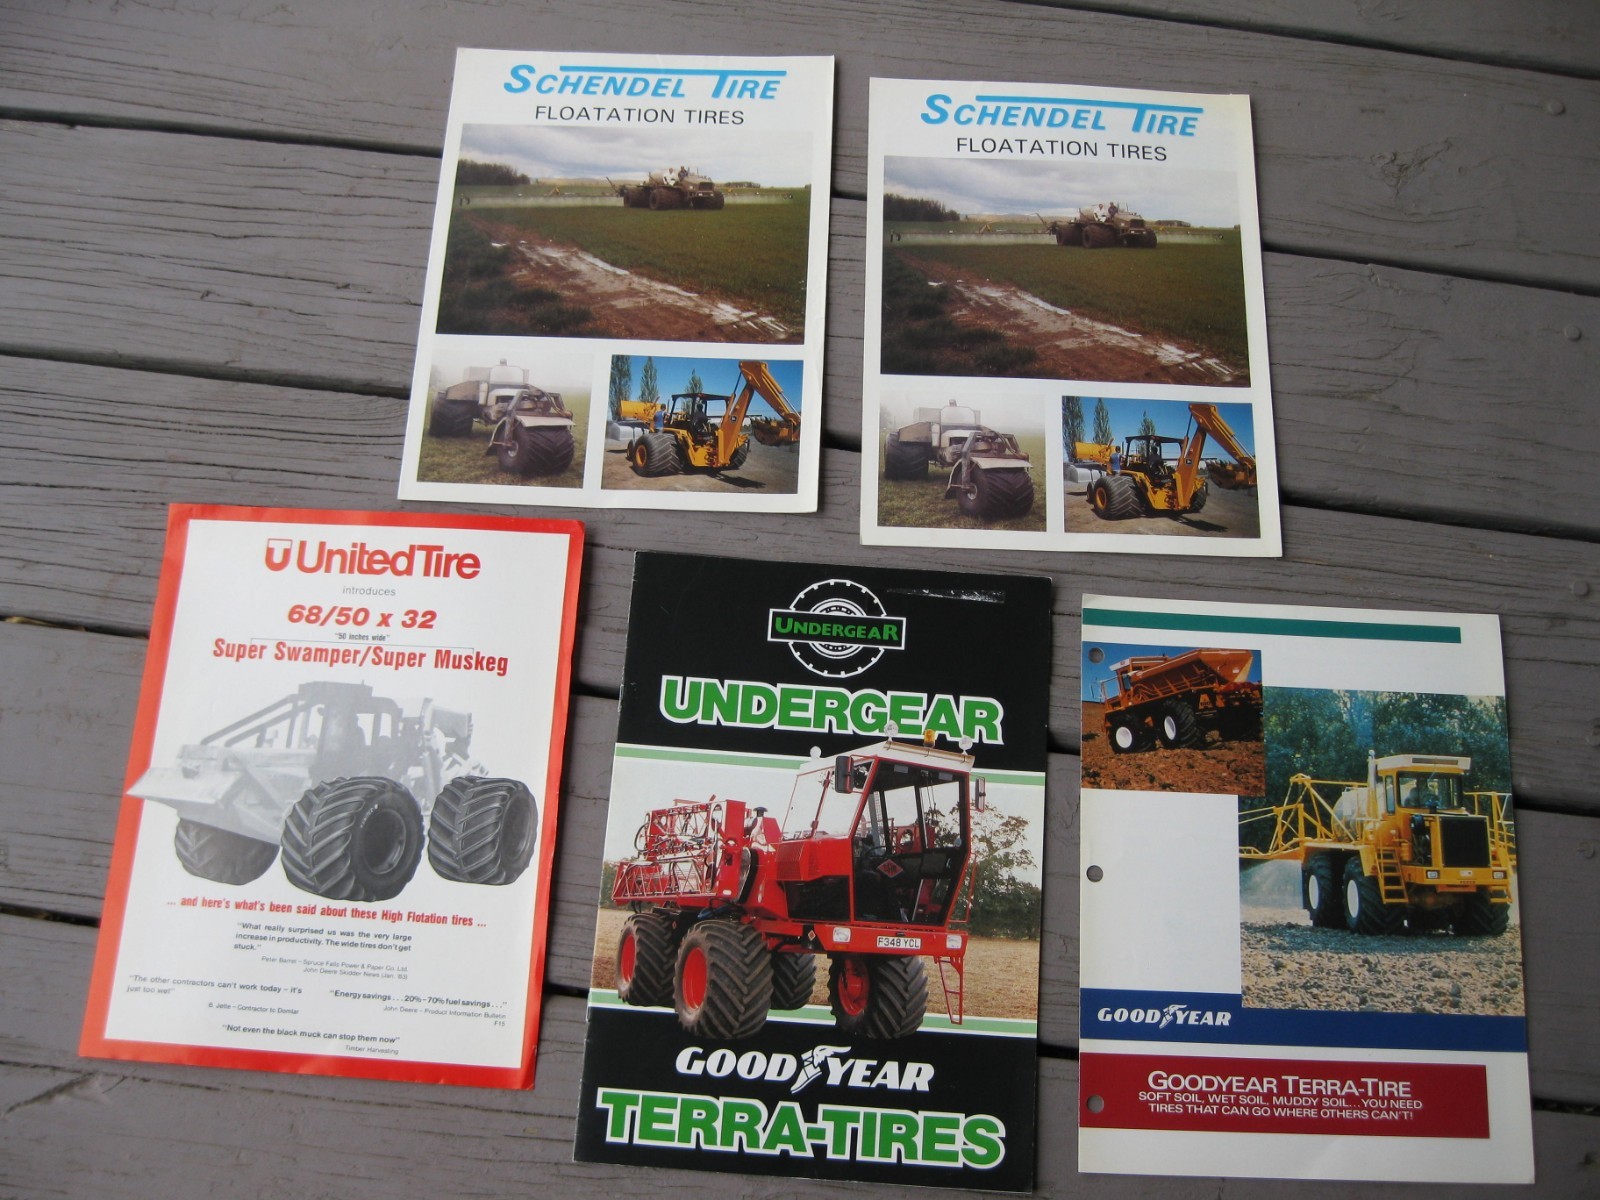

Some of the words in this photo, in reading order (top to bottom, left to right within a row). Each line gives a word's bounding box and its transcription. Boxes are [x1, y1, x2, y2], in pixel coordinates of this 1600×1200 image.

[503, 64, 686, 98] SCHENDEL
[710, 71, 787, 100] TIRE
[536, 105, 675, 123] FLOATATION
[684, 109, 744, 125] TIRES
[920, 94, 1106, 131] SCHENDEL
[1131, 106, 1203, 136] TIRE
[957, 138, 1098, 156] FLOATATION
[1107, 143, 1167, 161] TIRES
[343, 586, 396, 596] introduces
[288, 604, 370, 626] 68/50
[377, 612, 394, 628] x
[401, 610, 437, 629] 32
[349, 633, 369, 641] inches
[775, 617, 899, 642] UNDERGEAR
[213, 638, 267, 662] Super
[434, 649, 508, 676] Muskeg
[660, 674, 1004, 745] UNDERGEAR
[181, 897, 198, 906] and
[202, 897, 230, 908] here's
[235, 900, 265, 911] what's
[270, 901, 292, 913] been
[297, 904, 316, 915] said
[321, 906, 347, 917] about
[351, 908, 377, 919] these
[382, 910, 402, 923] High
[407, 912, 447, 924] Flotation
[452, 915, 473, 926] tires
[265, 925, 285, 933] really
[288, 926, 323, 935] surprised
[236, 933, 267, 941] increase
[278, 936, 323, 946] productivity.
[341, 940, 358, 948] wide
[878, 937, 901, 946] F348
[904, 939, 919, 947] YCL
[367, 964, 384, 972] Paper
[127, 985, 140, 993] just
[150, 976, 169, 984] other
[173, 978, 215, 987] contractors
[217, 981, 236, 989] can't
[240, 983, 257, 991] work
[261, 985, 281, 993] today
[238, 1004, 268, 1012] Contractor
[446, 997, 460, 1005] fuel
[449, 1010, 482, 1018] Information
[484, 1011, 506, 1019] Bulletin
[263, 1026, 274, 1035] the
[277, 1028, 297, 1036] black
[300, 1030, 321, 1038] muck
[339, 1033, 355, 1041] stop
[358, 1034, 377, 1042] them
[367, 1047, 399, 1055] Harvesting
[1148, 1070, 1277, 1093] GOODYEAR
[1282, 1075, 1411, 1097] TERRA-TIRE
[1138, 1091, 1171, 1101] SOFT
[1174, 1093, 1205, 1103] SOIL,
[1208, 1094, 1236, 1104] WET
[1239, 1095, 1269, 1105] SOIL,
[1272, 1096, 1319, 1106] MUDDY
[1390, 1100, 1422, 1108] NEED
[1149, 1103, 1183, 1113] TIRES
[1186, 1104, 1219, 1114] THAT
[1221, 1105, 1249, 1115] CAN
[1252, 1107, 1270, 1116] GO
[1273, 1108, 1318, 1118] WHERE
[1320, 1109, 1369, 1119] OTHERS
[1371, 1110, 1413, 1120] CAN'T!
[596, 1087, 1006, 1170] TERRA-TIRES
